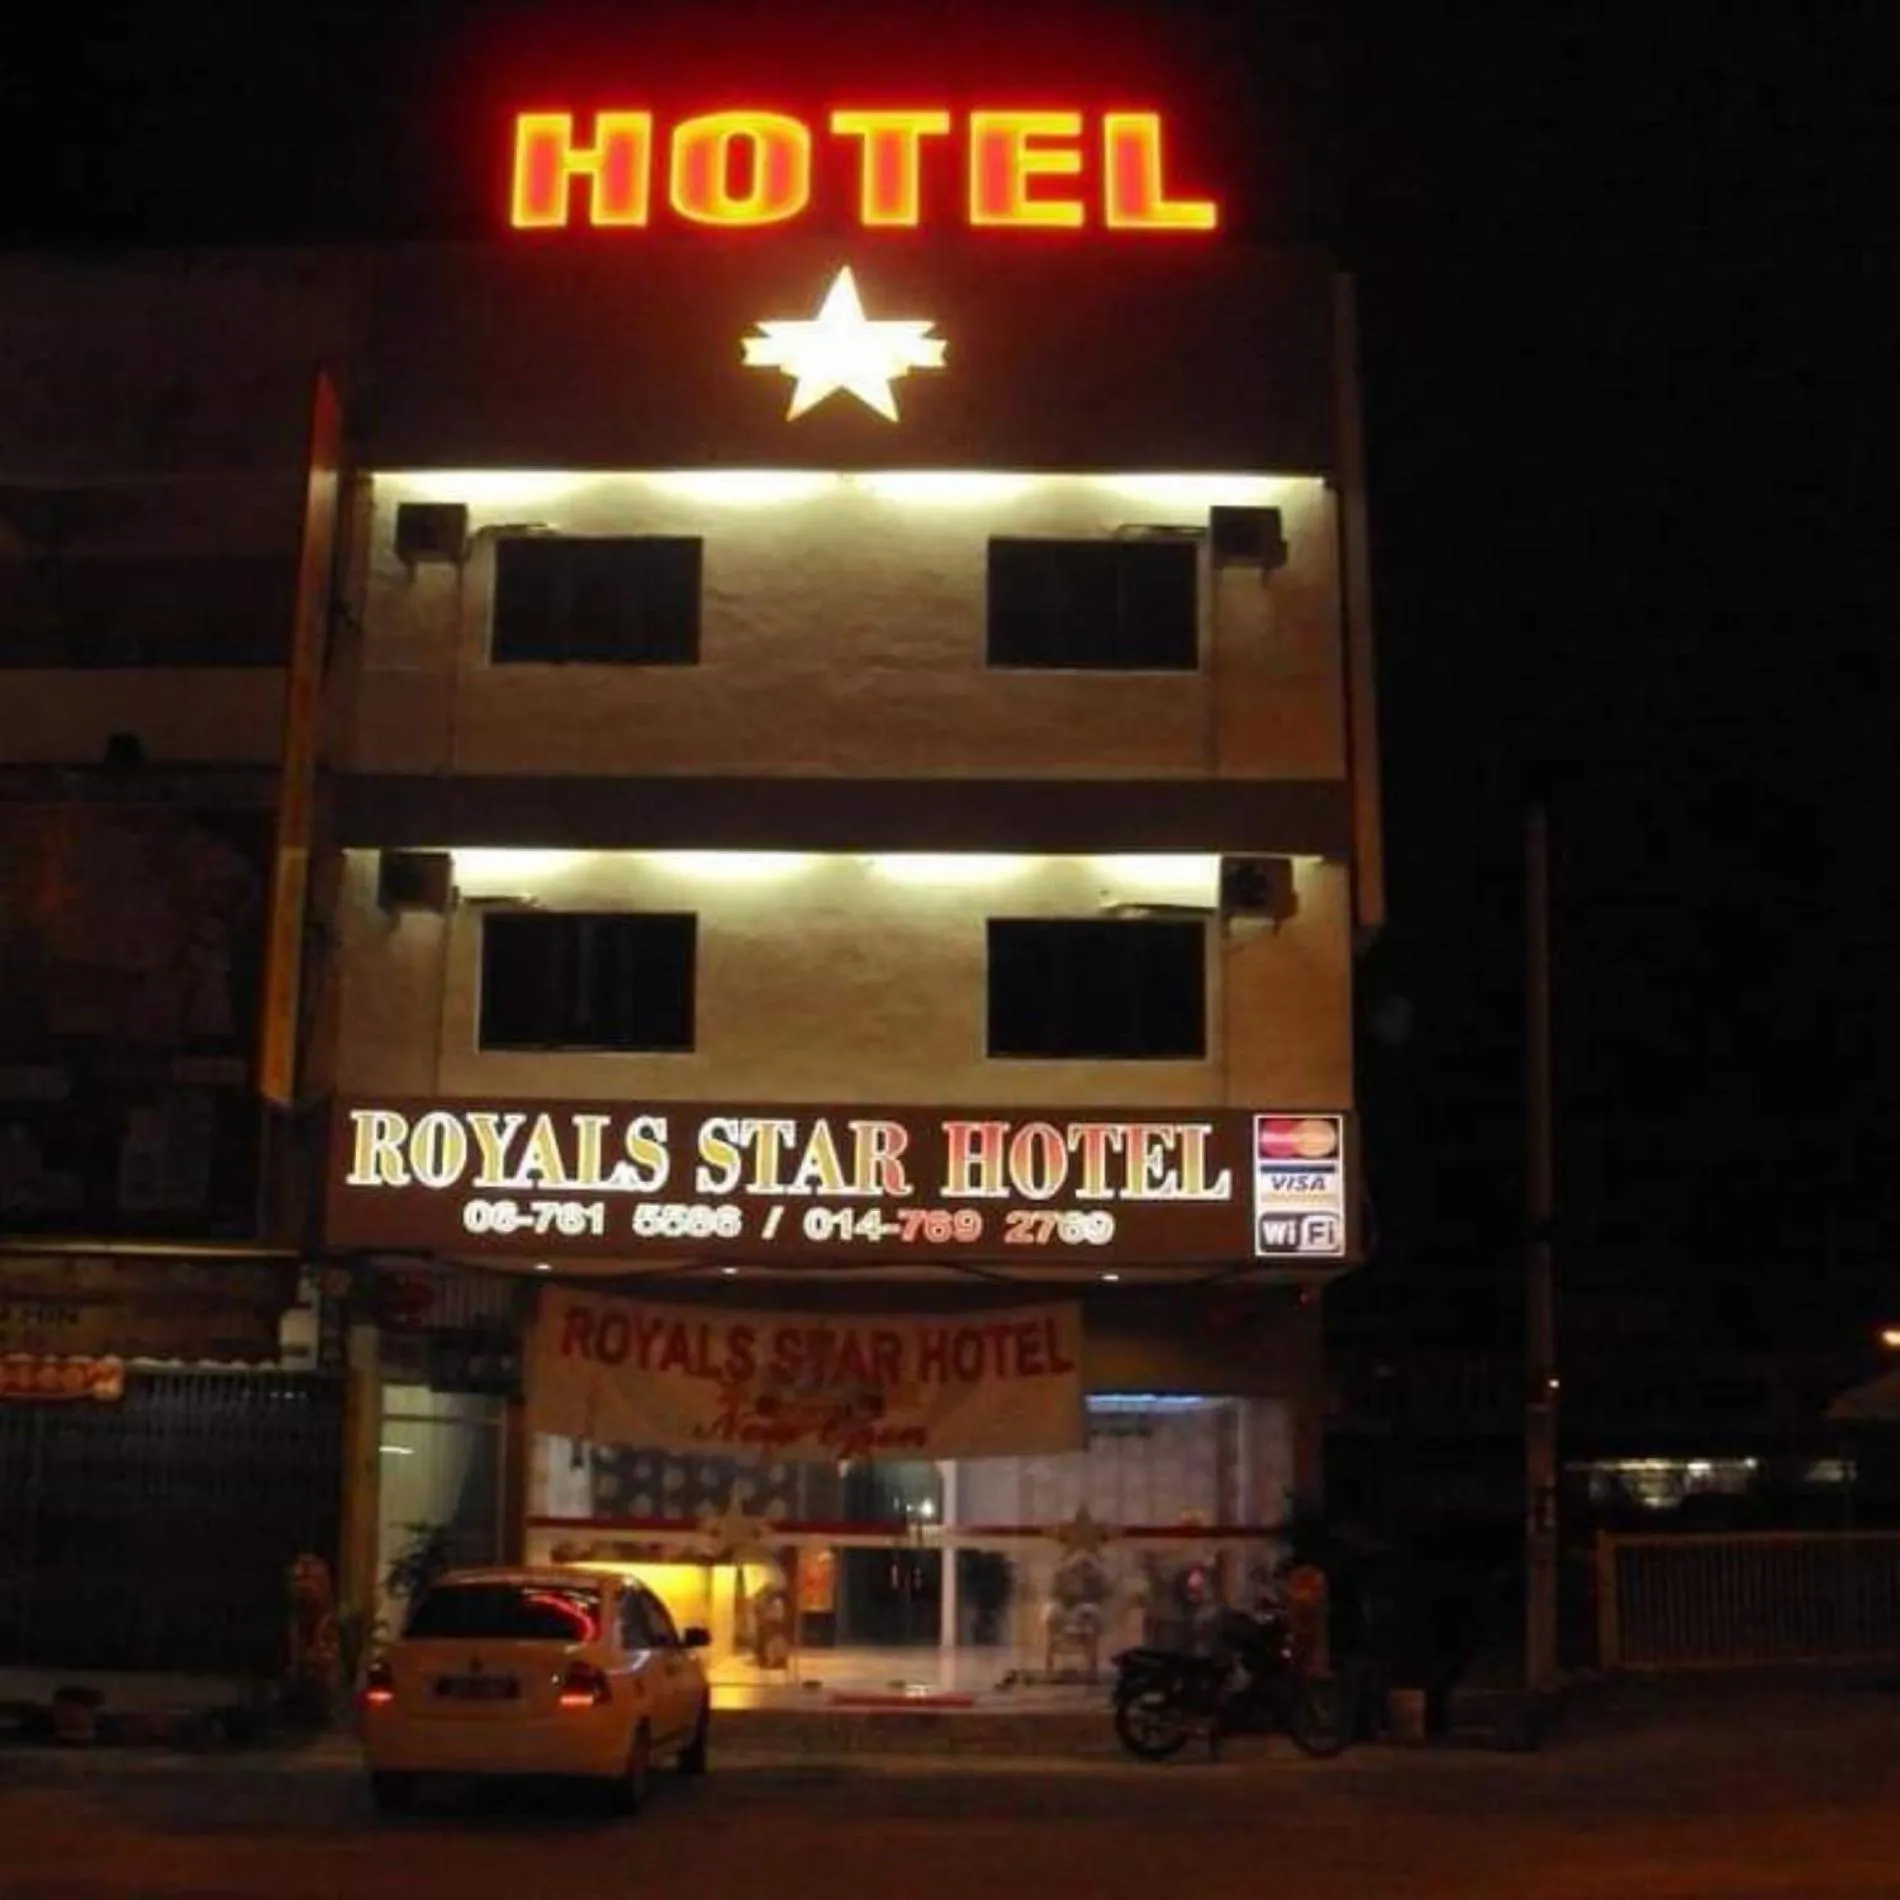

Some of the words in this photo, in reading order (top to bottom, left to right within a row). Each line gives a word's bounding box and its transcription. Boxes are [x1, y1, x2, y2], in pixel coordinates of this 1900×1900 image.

[511, 110, 1217, 229] HOTEL
[345, 1108, 671, 1193] ROYALS
[696, 1116, 912, 1197] STAR
[940, 1119, 1232, 1200] HOTEL
[1270, 1174, 1327, 1192] VISA
[561, 1306, 755, 1383] ROYALS
[772, 1326, 901, 1385] STAR
[918, 1317, 1074, 1384] HOTEL
